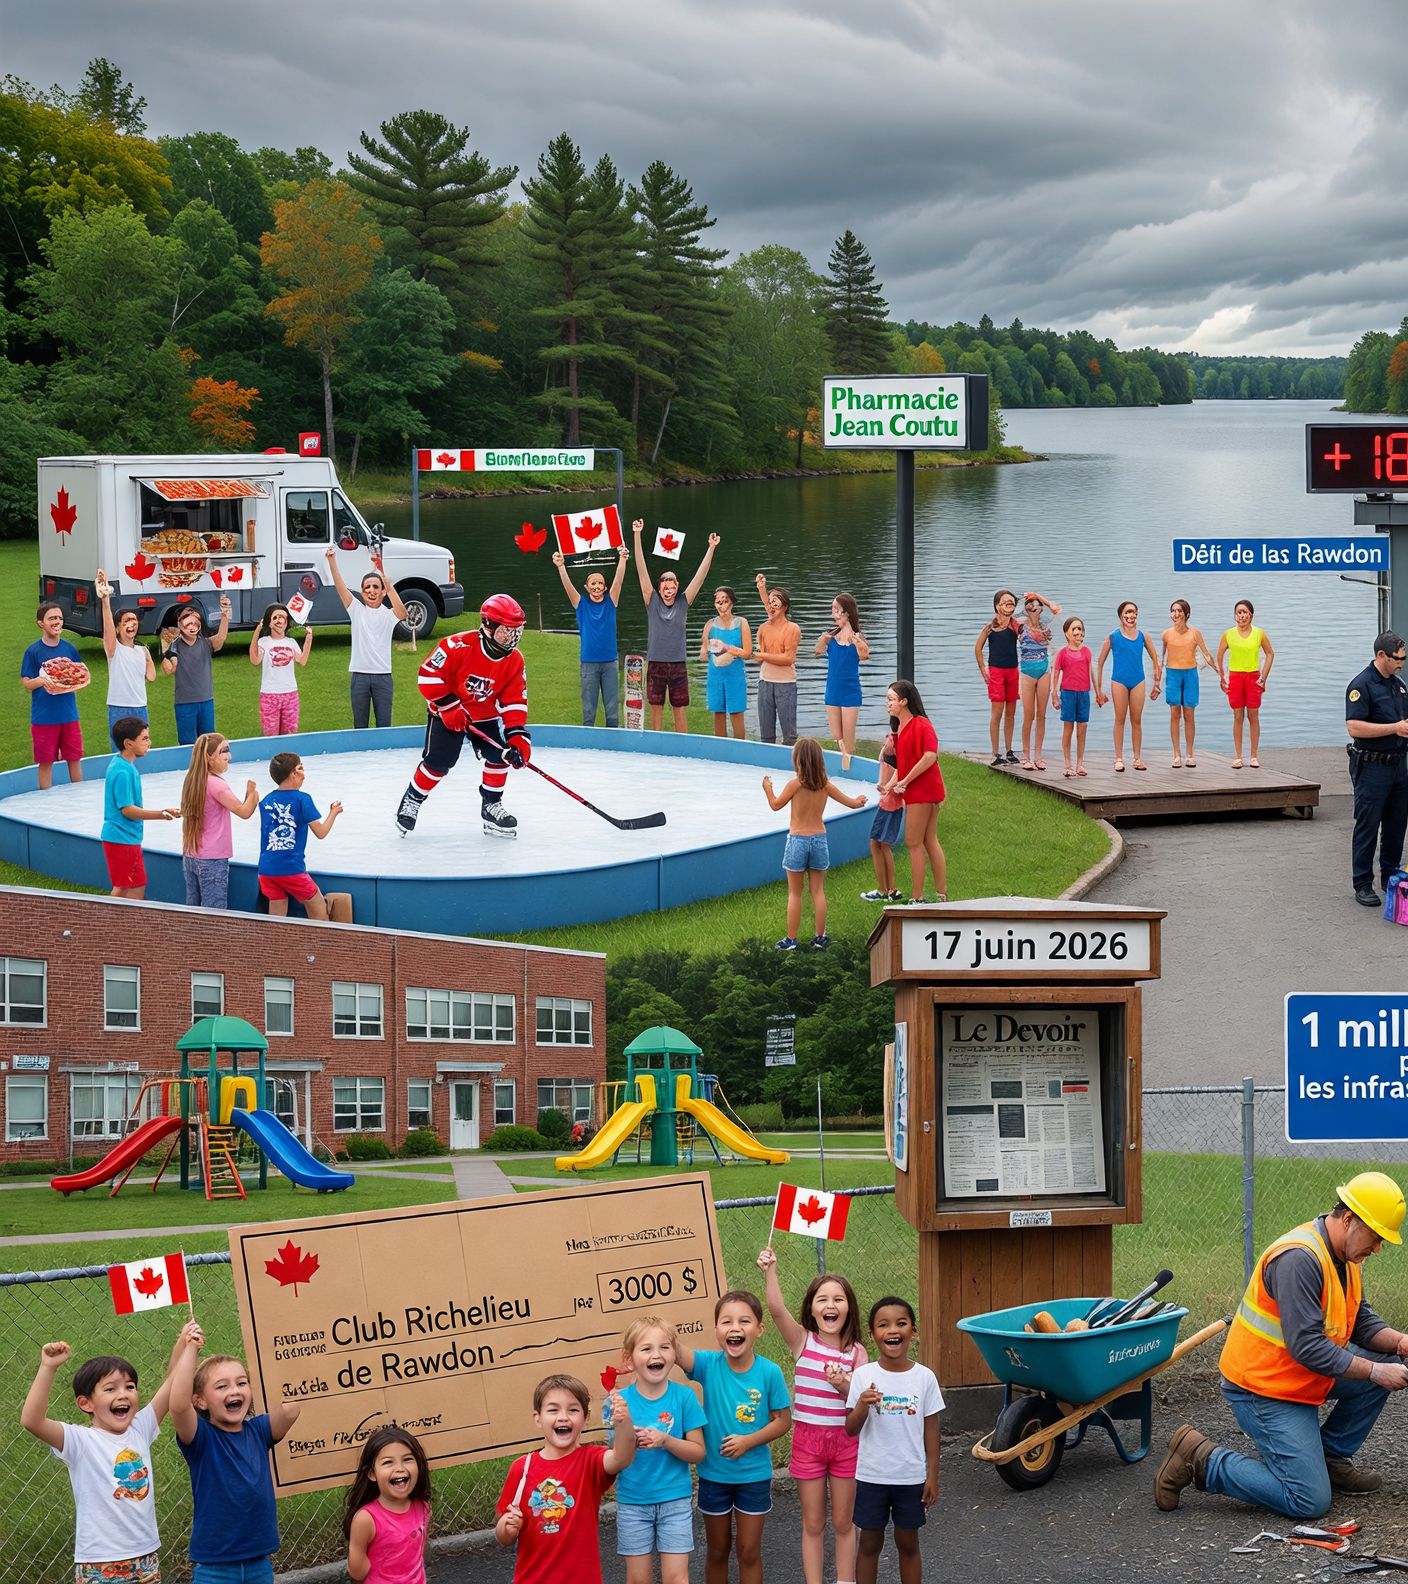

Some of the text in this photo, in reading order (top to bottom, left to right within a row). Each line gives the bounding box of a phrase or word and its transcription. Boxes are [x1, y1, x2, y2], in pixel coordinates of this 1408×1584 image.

[831, 386, 959, 411] Pharmacie
[829, 413, 958, 437] Jean Coutu
[1229, 543, 1254, 565] de
[1297, 542, 1382, 564] Rawdon
[924, 929, 1128, 969] 17 juin 2026
[950, 1014, 1086, 1043] Le Devoir
[1301, 1011, 1319, 1048] 1
[1299, 1075, 1335, 1099] les
[608, 1266, 697, 1305] 3000 $
[331, 1311, 397, 1346] Club
[404, 1295, 531, 1336] Richelieu
[337, 1359, 372, 1389] de
[381, 1341, 495, 1382] Rawdon
